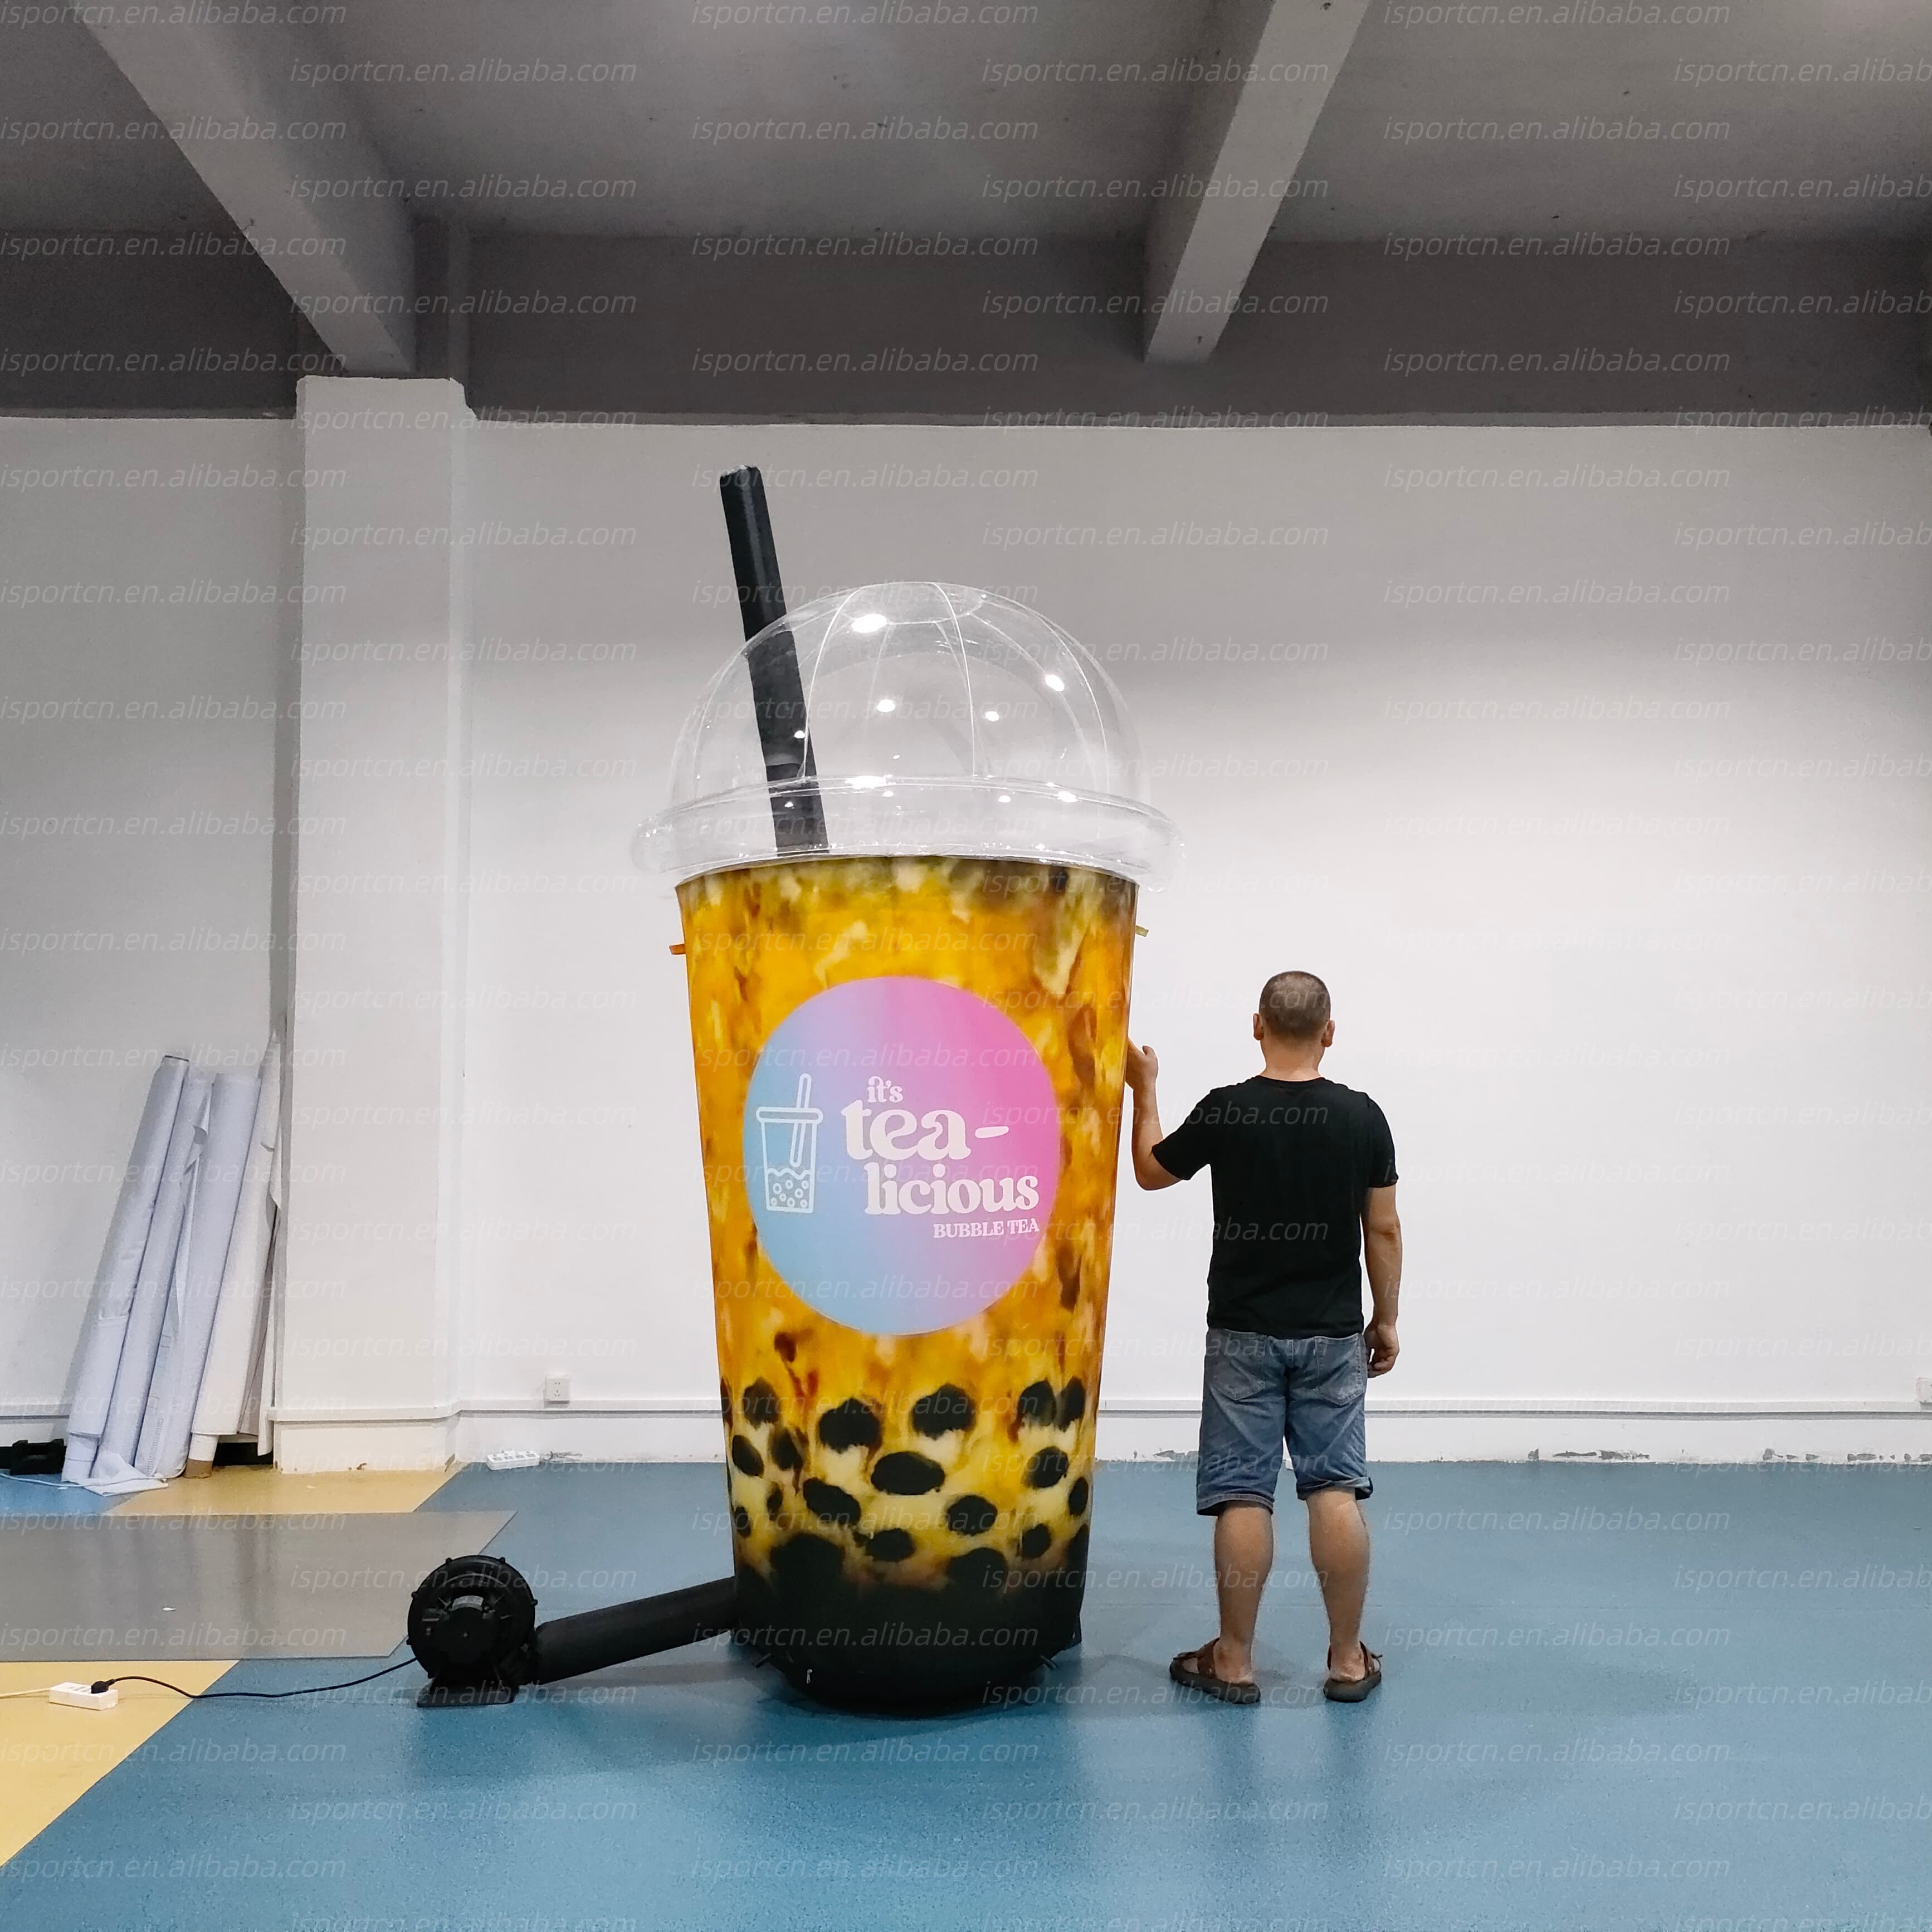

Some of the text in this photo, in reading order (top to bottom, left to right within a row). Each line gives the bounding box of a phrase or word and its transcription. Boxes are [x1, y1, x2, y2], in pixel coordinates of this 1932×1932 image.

[867, 1076, 904, 1103] it's
[841, 1100, 1009, 1160] tea-
[863, 1162, 1039, 1215] licious
[933, 1218, 1040, 1238] BUBBLE TEA
